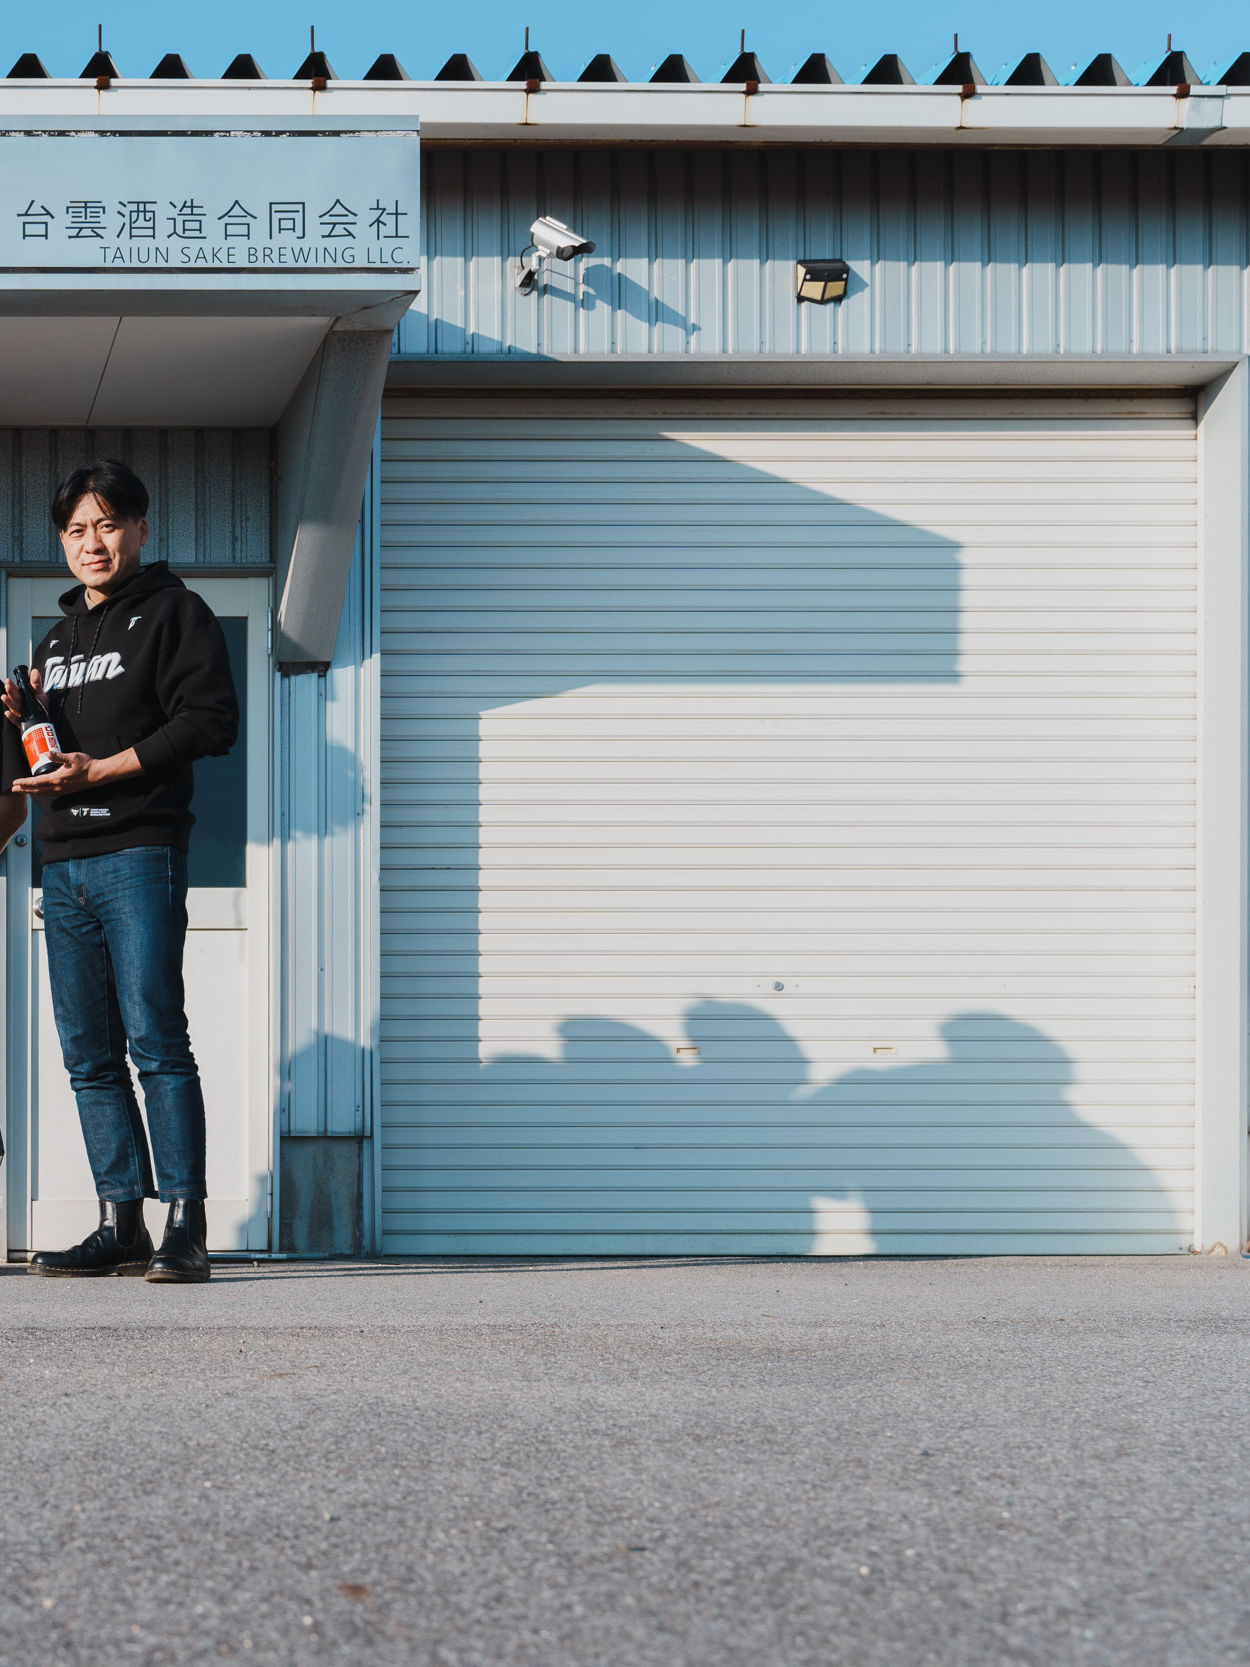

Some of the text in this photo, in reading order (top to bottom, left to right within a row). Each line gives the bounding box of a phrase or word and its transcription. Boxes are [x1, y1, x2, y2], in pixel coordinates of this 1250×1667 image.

[16, 198, 410, 241] 台雲酒造合同会社
[99, 246, 169, 264] TAIUN
[180, 246, 237, 264] SAKE
[247, 246, 355, 264] BREWING
